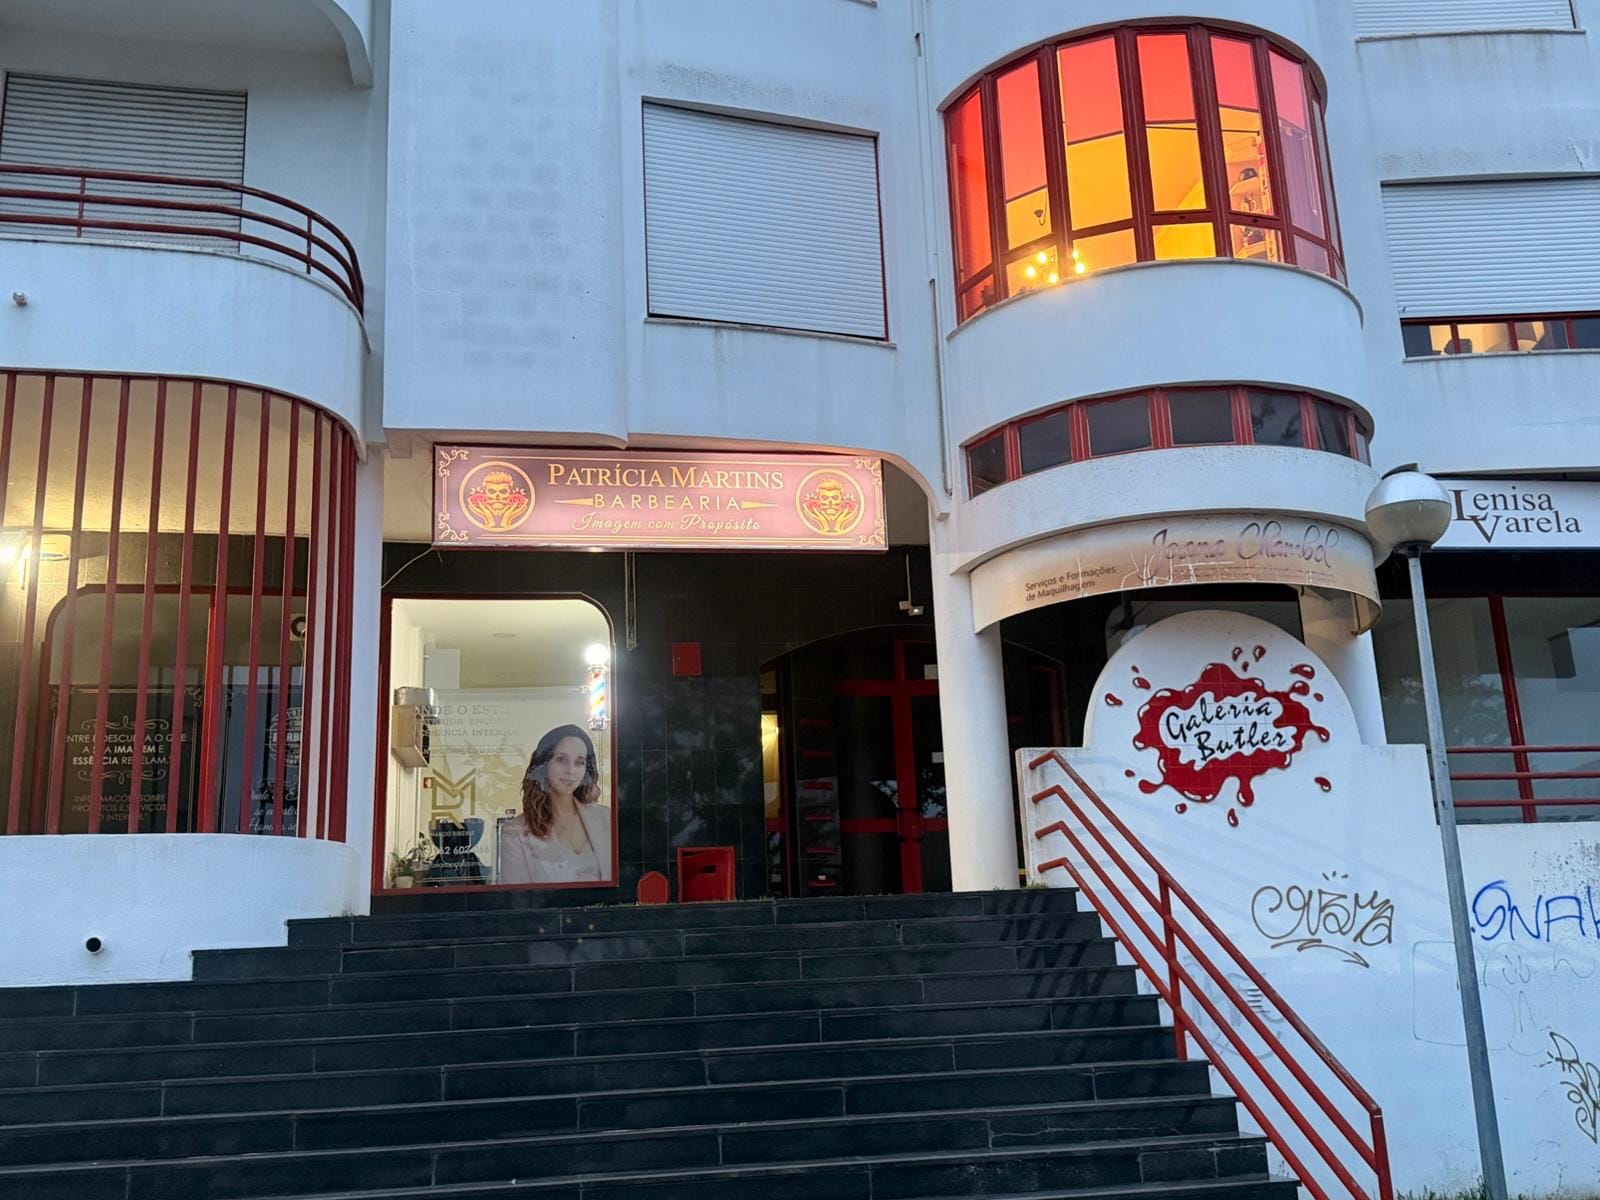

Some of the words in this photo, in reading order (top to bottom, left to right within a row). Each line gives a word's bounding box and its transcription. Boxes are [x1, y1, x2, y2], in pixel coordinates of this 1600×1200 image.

[548, 463, 665, 488] PATRÍCIA
[671, 466, 784, 490] MARTINS
[593, 494, 740, 511] BARBEARIA
[1448, 486, 1555, 521] Lenisa
[571, 511, 642, 533] Imagem
[648, 521, 675, 530] com
[680, 513, 761, 534] Propósito
[1468, 511, 1582, 543] Varela
[1025, 577, 1057, 591] Serviços
[1066, 566, 1117, 580] Formações
[1026, 592, 1036, 601] de
[1037, 581, 1096, 598] Maquilhagem
[1166, 696, 1272, 743] Galeria
[64, 734, 90, 743] NTRE
[154, 734, 163, 742] O
[82, 745, 90, 753] A
[114, 745, 156, 753] IMAEM
[158, 745, 164, 753] E
[1194, 721, 1287, 761] Butler
[72, 755, 119, 765] ESSÊCIA
